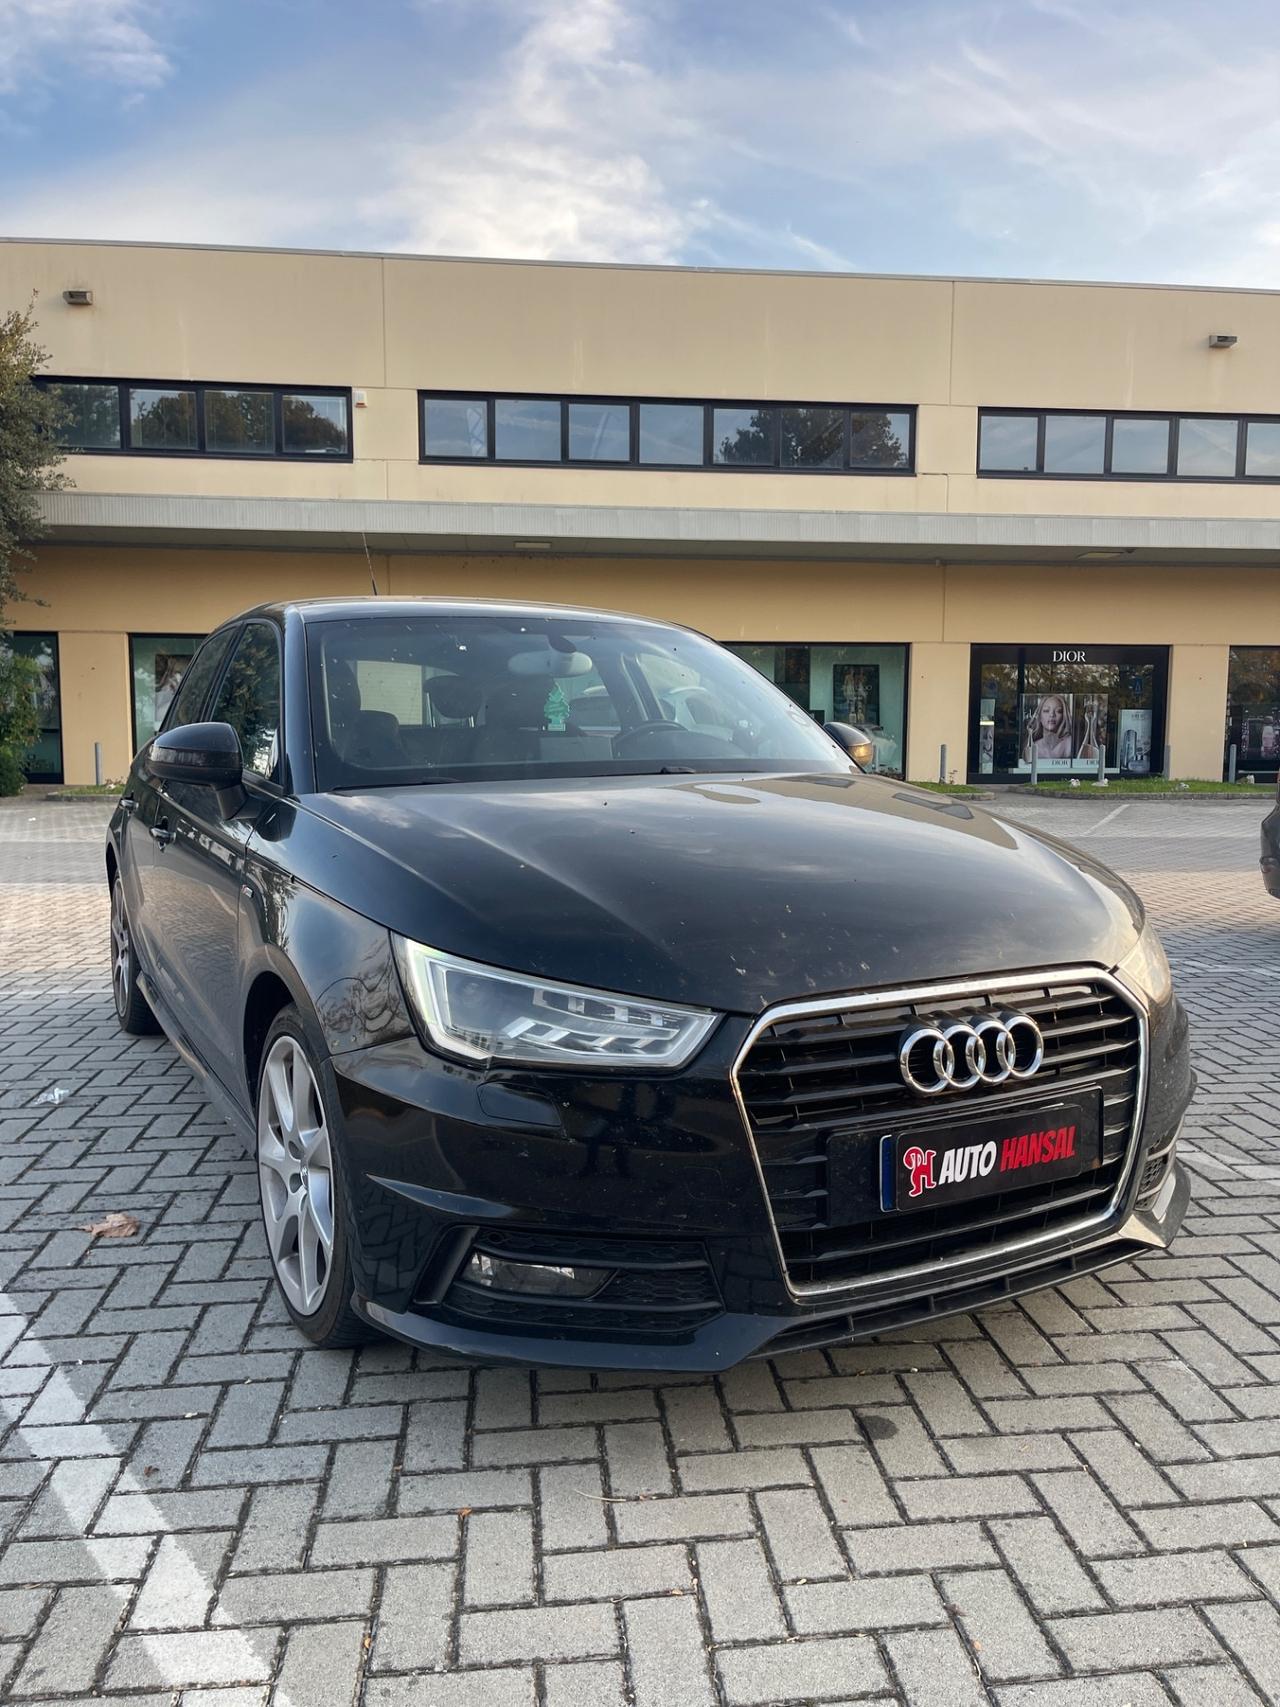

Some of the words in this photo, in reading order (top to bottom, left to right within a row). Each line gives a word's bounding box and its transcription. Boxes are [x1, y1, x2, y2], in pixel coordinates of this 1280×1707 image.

[1053, 650, 1086, 663] DIOR
[938, 1140, 997, 1185] AUTO
[1000, 1126, 1075, 1172] HANSAL
